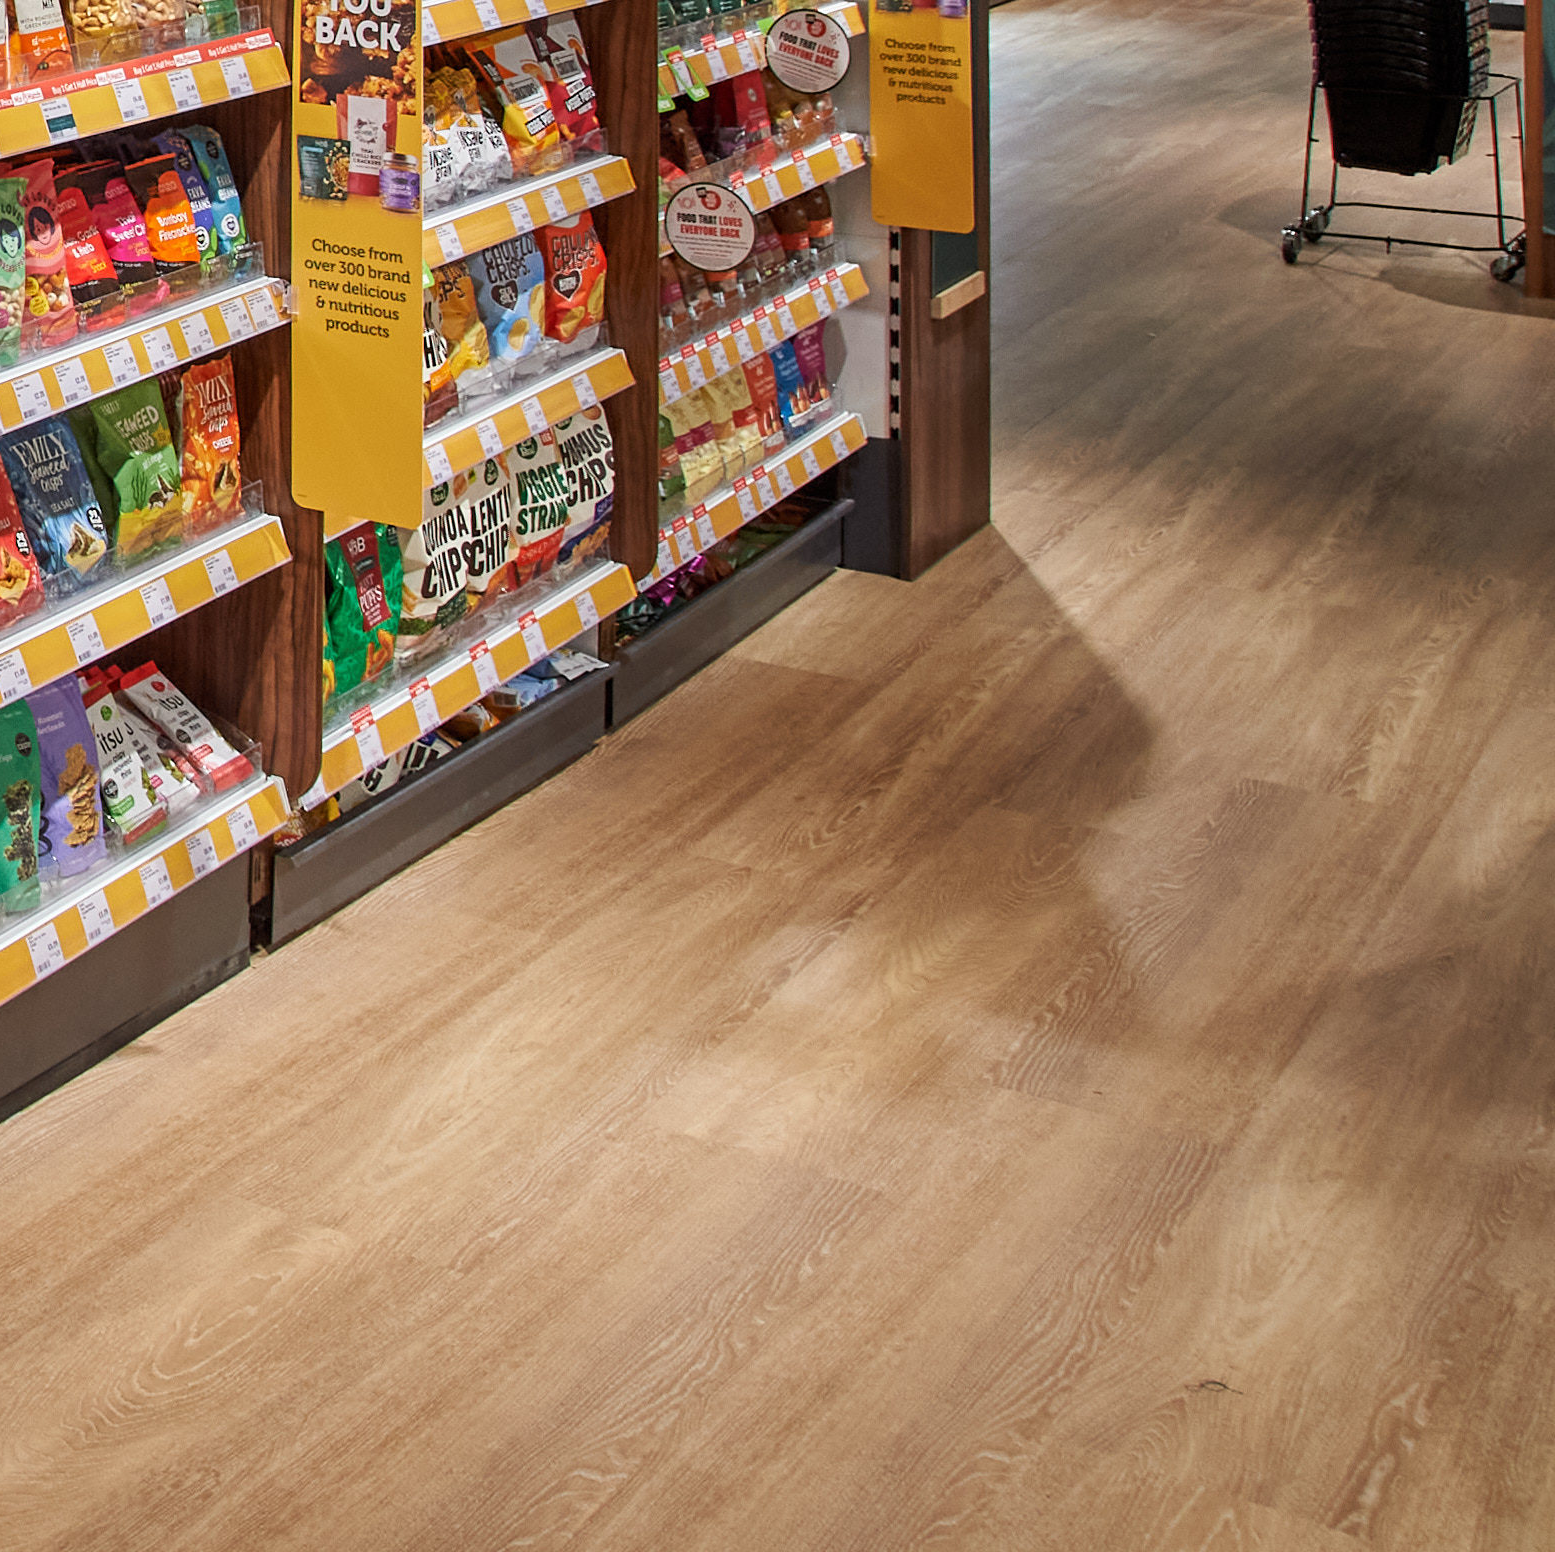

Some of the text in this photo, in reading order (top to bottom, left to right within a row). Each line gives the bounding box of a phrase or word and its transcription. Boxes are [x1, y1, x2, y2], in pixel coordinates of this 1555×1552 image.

[316, 16, 401, 52] BACK
[312, 239, 403, 264] Choose from
[304, 258, 411, 284] over 300 brand
[309, 278, 406, 303] new delicious
[316, 296, 399, 321] & nutritious
[325, 317, 389, 339] products
[10, 428, 69, 468] EMILY
[98, 726, 124, 755] itsu
